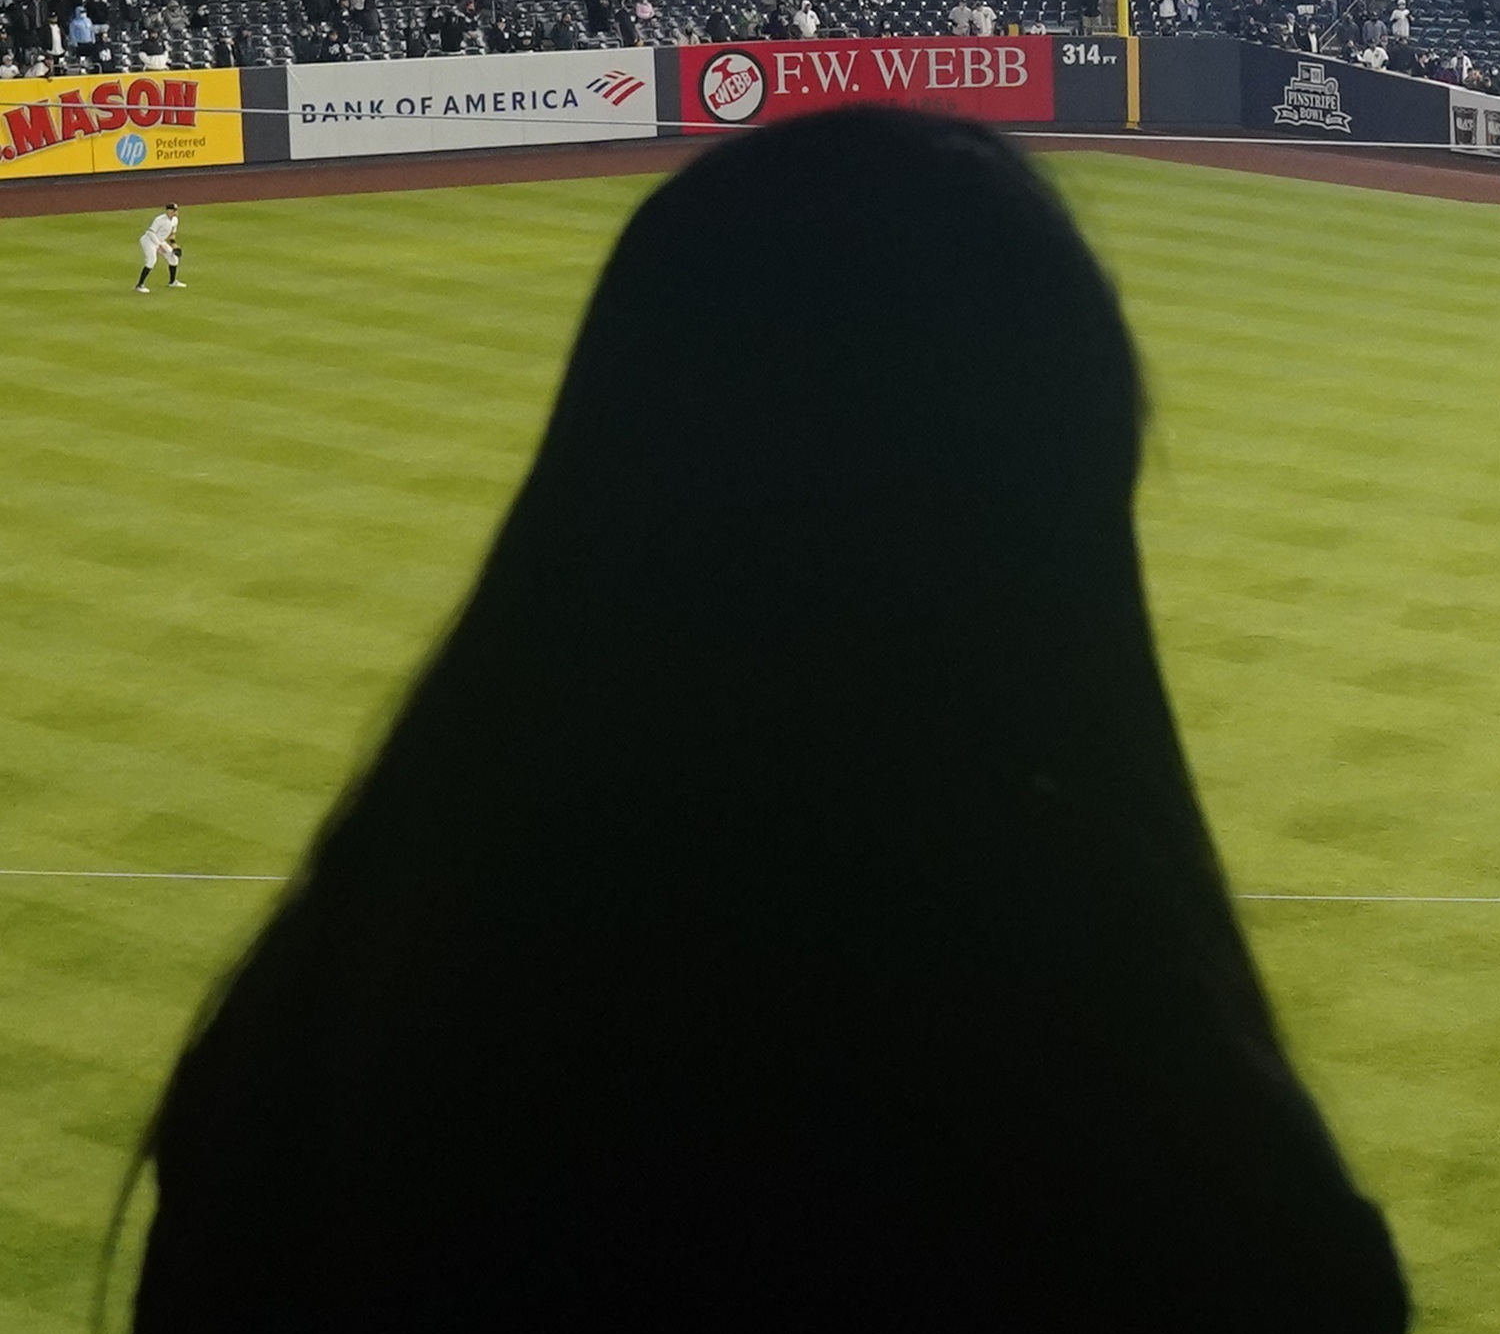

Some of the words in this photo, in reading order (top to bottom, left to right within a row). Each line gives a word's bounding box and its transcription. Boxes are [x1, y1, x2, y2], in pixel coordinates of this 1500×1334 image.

[1061, 44, 1100, 65] 314
[1102, 55, 1117, 65] FT
[772, 51, 859, 95] F.W.
[871, 46, 1028, 91] WEBB
[714, 71, 757, 104] WEBB
[302, 100, 386, 125] BANK
[396, 96, 432, 116] OF
[443, 89, 579, 116] AMERICA
[1288, 91, 1337, 111] PINSTRIPE
[1299, 107, 1325, 123] BOWL
[119, 133, 145, 167] hp
[156, 136, 206, 149] Preferred
[156, 148, 196, 161] Partner
